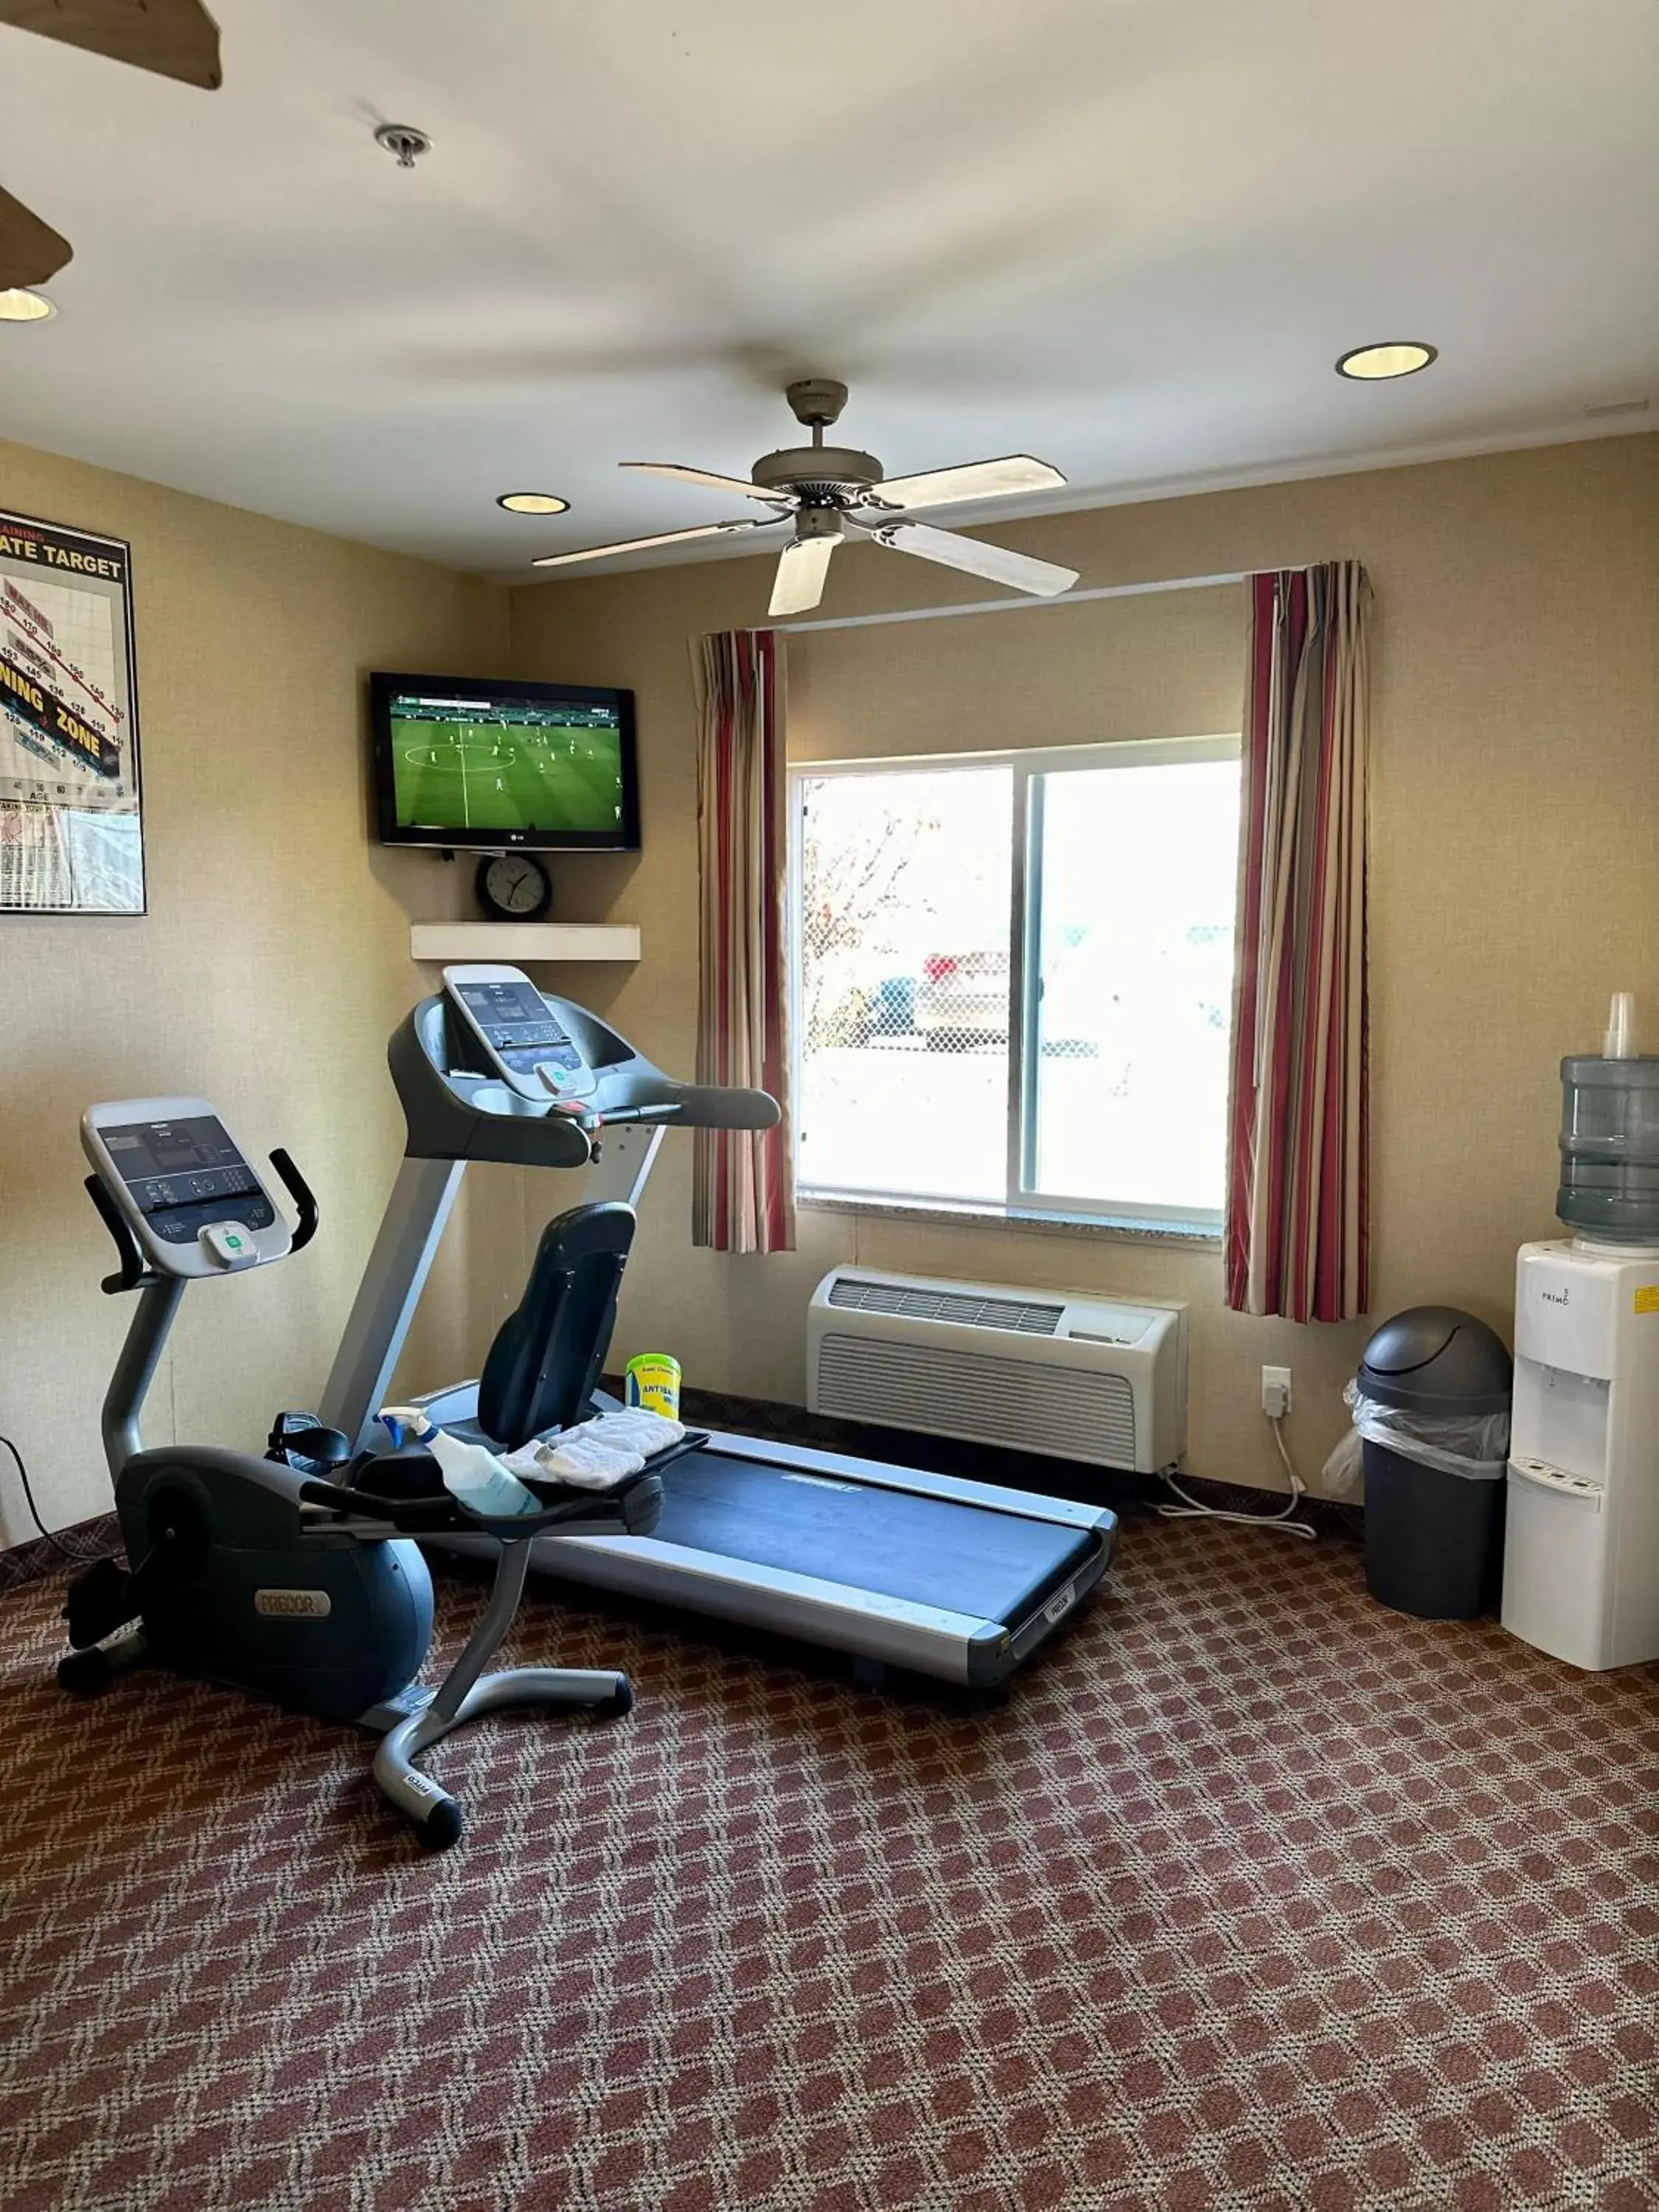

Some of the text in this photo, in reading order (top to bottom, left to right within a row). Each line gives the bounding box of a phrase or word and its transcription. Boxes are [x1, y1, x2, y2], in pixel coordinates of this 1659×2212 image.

[0, 535, 121, 578] ATE TARGET
[24, 619, 38, 634] 170
[0, 662, 100, 758] NING ZONE
[29, 793, 49, 801] AGE
